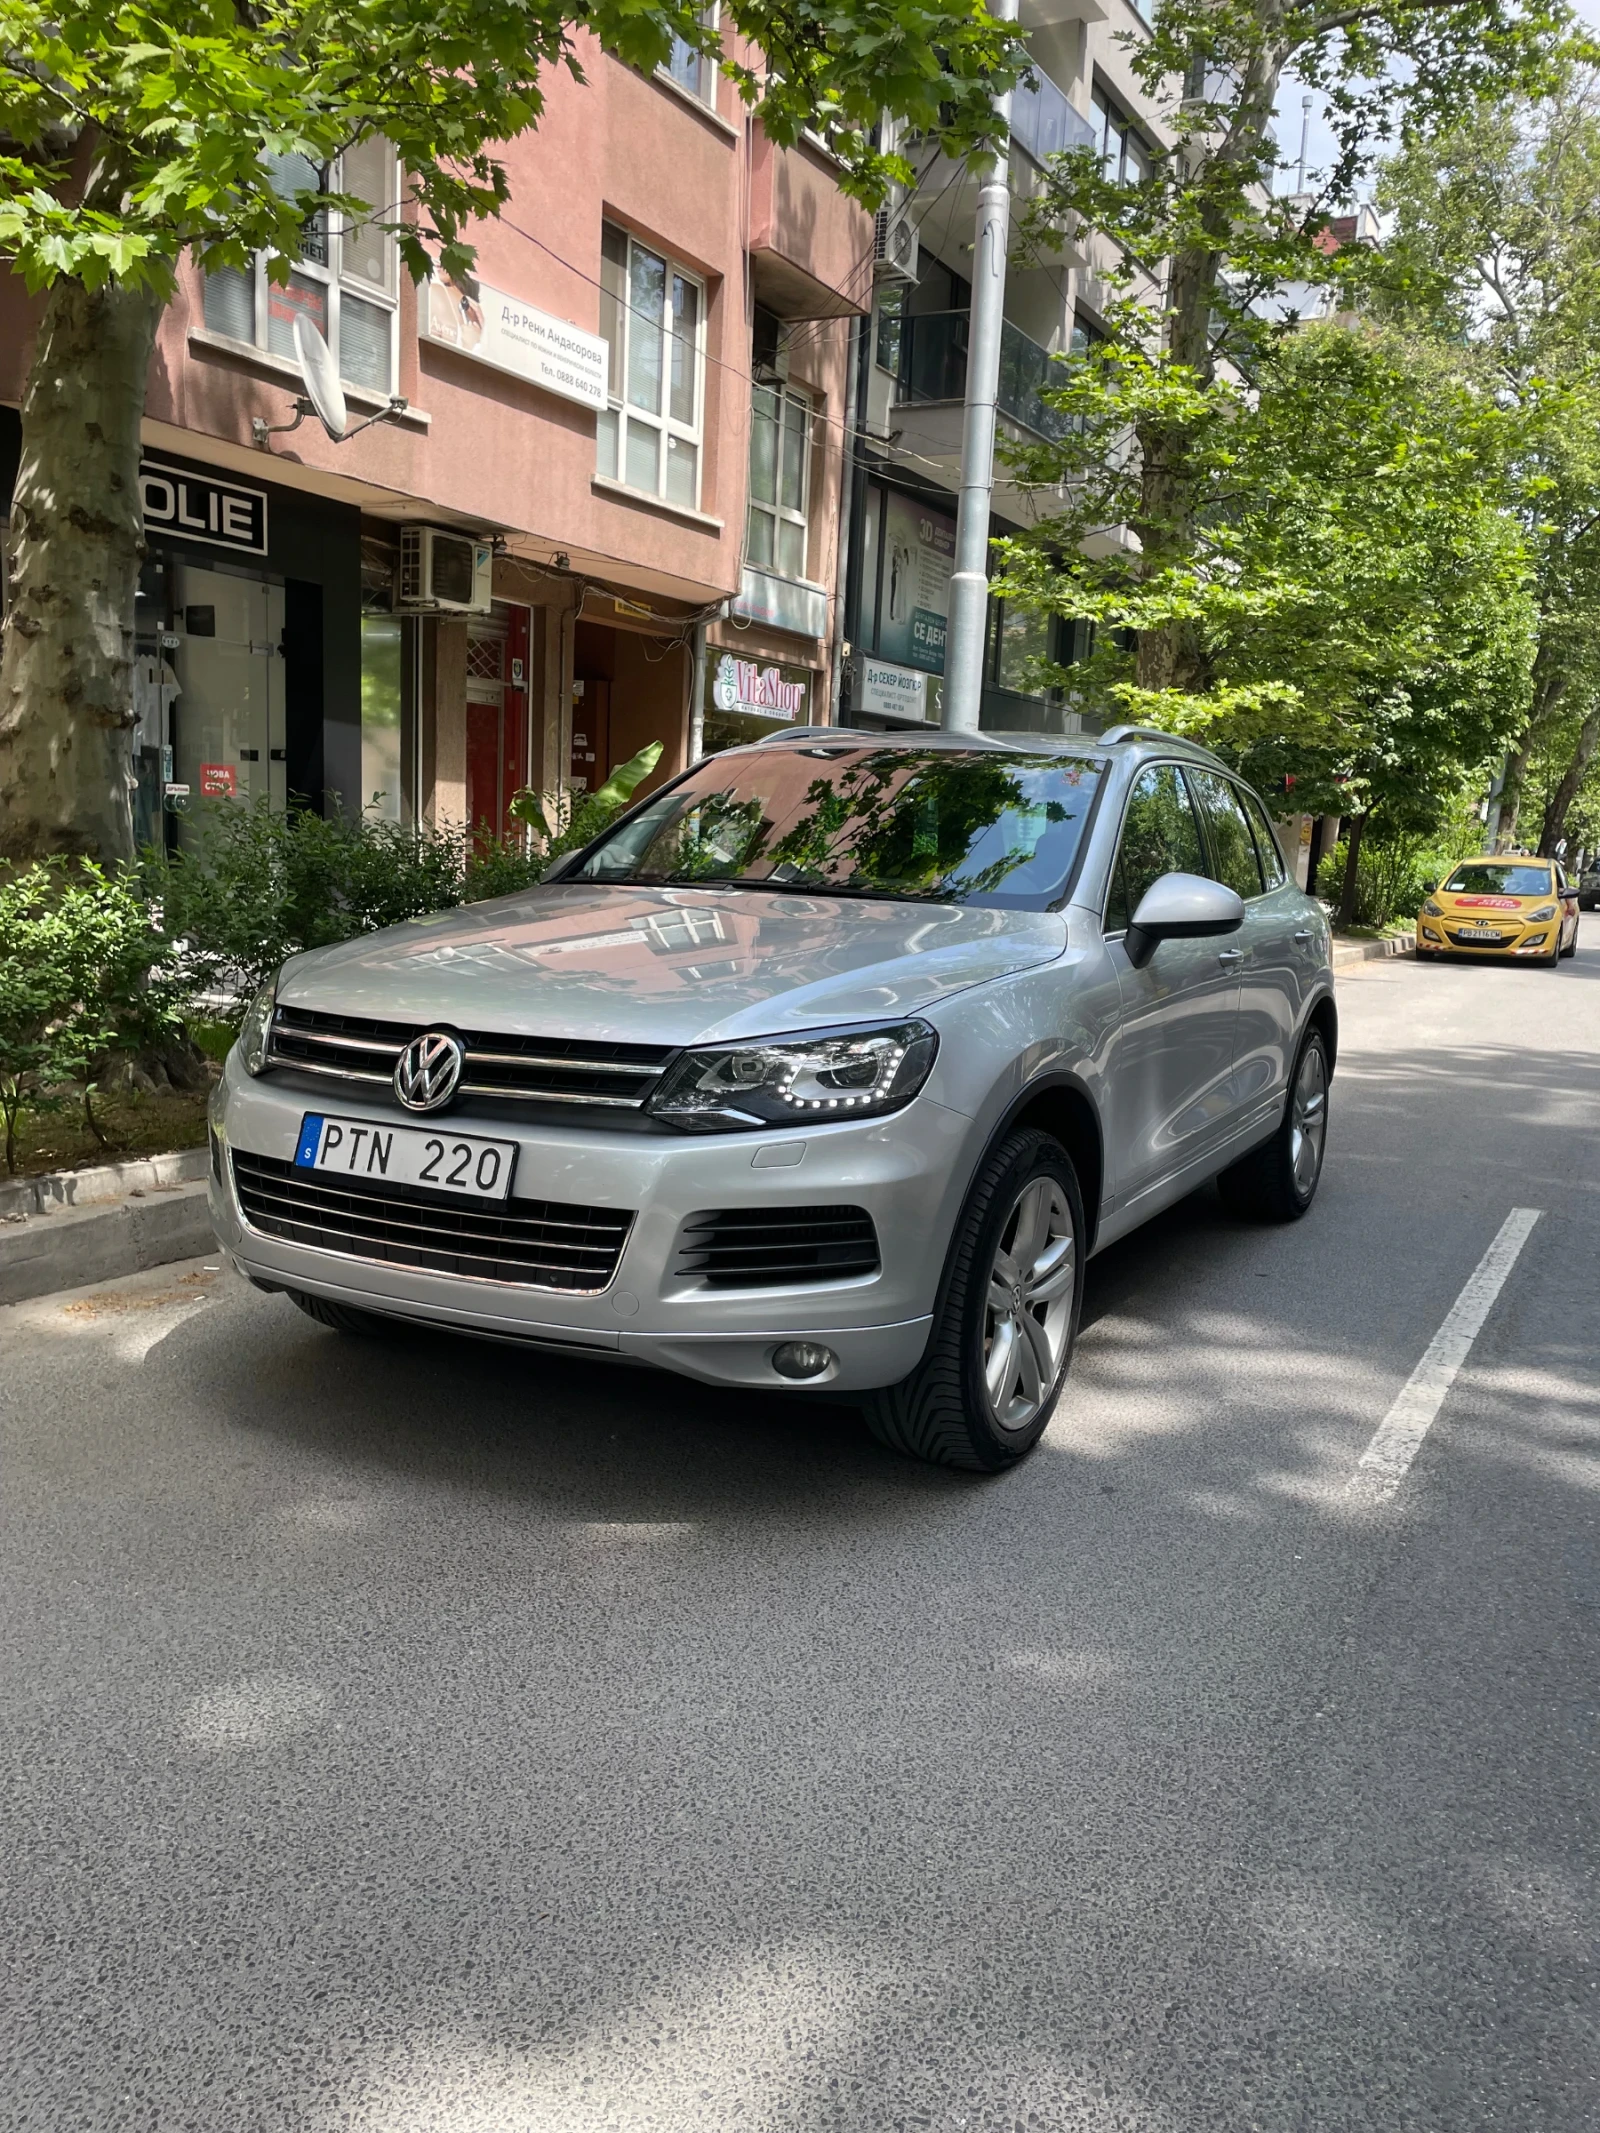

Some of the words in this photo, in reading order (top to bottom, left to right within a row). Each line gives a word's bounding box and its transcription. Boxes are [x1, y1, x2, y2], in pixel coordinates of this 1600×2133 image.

[501, 306, 520, 327] Д-р
[522, 315, 545, 338] Рени
[547, 328, 602, 365] Андасорова
[541, 362, 556, 378] Тел.
[556, 369, 574, 386] 0888
[575, 378, 588, 392] 640
[589, 384, 602, 398] 278
[920, 518, 933, 542] 3D
[914, 621, 926, 641] СЕ
[736, 660, 801, 720] VitaShop
[867, 669, 878, 685] Д-р
[879, 671, 898, 686] СЕХЕР
[304, 1147, 312, 1159] S
[319, 1123, 394, 1175] PTN
[418, 1138, 502, 1191] 220
